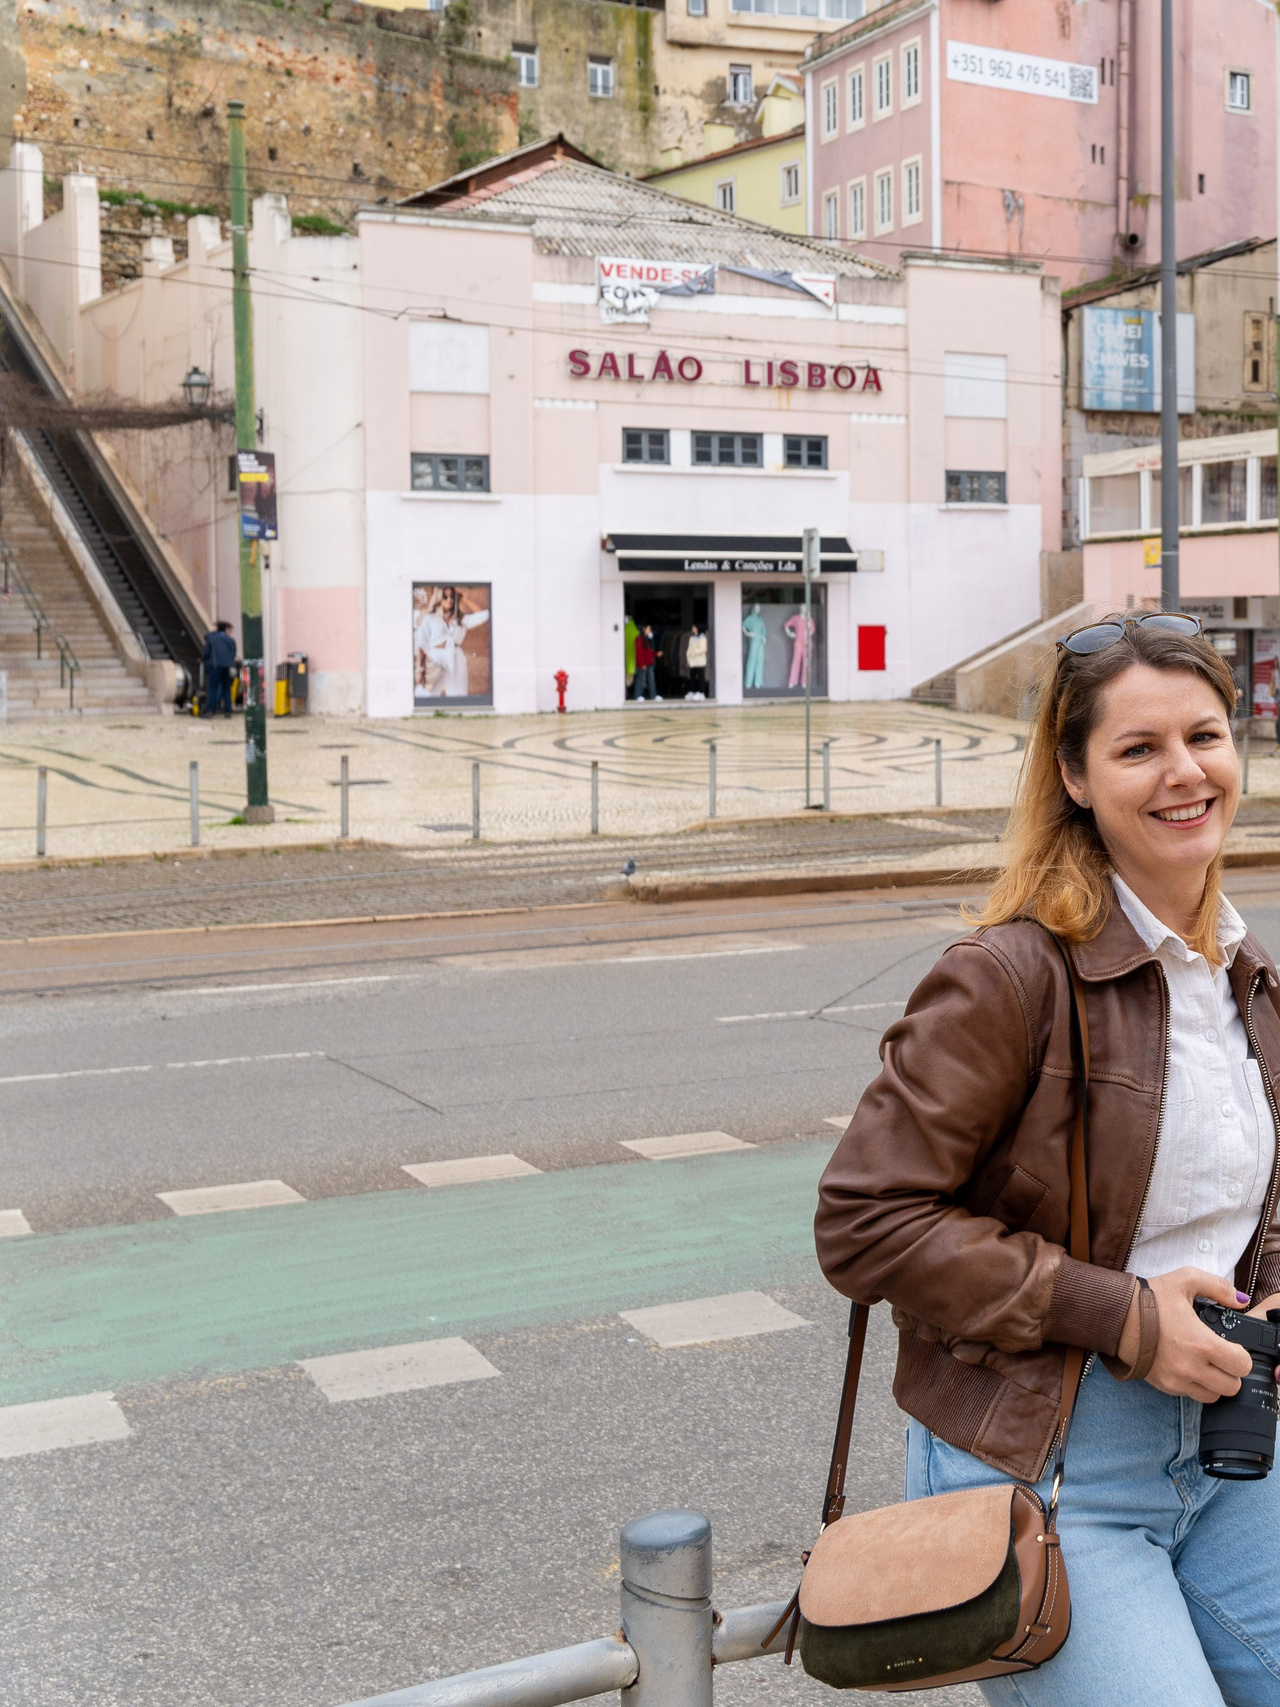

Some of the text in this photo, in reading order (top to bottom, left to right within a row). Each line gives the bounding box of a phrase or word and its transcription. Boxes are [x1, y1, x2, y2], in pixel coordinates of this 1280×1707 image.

[951, 53, 1067, 89] +351 962 476 541
[743, 359, 882, 392] LISBOA
[684, 559, 797, 572] Lendas & Canções Lda
